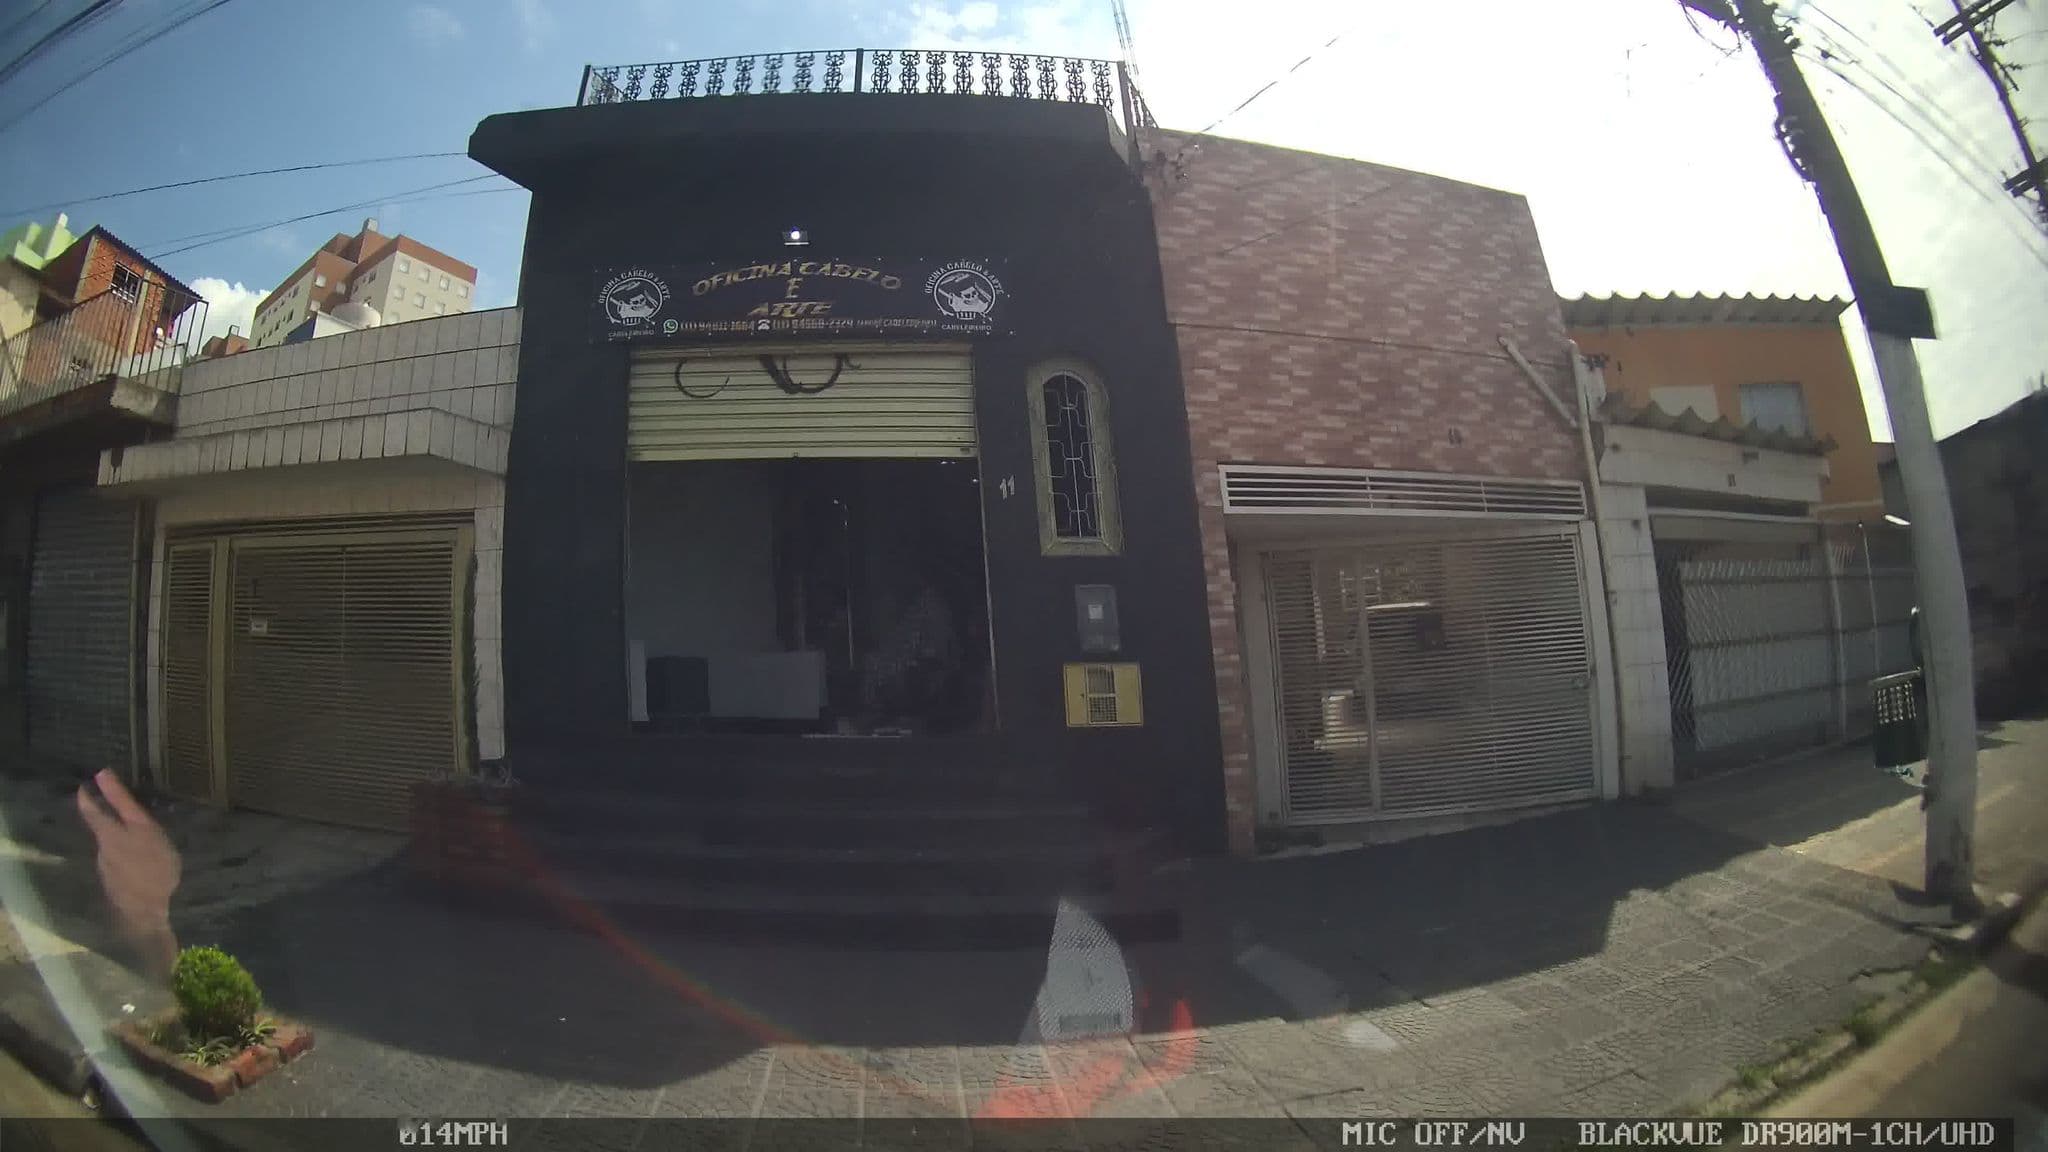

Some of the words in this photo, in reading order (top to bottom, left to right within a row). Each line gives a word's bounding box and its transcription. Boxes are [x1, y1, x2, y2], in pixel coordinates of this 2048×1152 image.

[693, 262, 791, 296] OFICINA
[799, 262, 901, 289] CABELO
[785, 277, 803, 299] E
[748, 301, 832, 318] ARTE
[1000, 475, 1015, 500] 11
